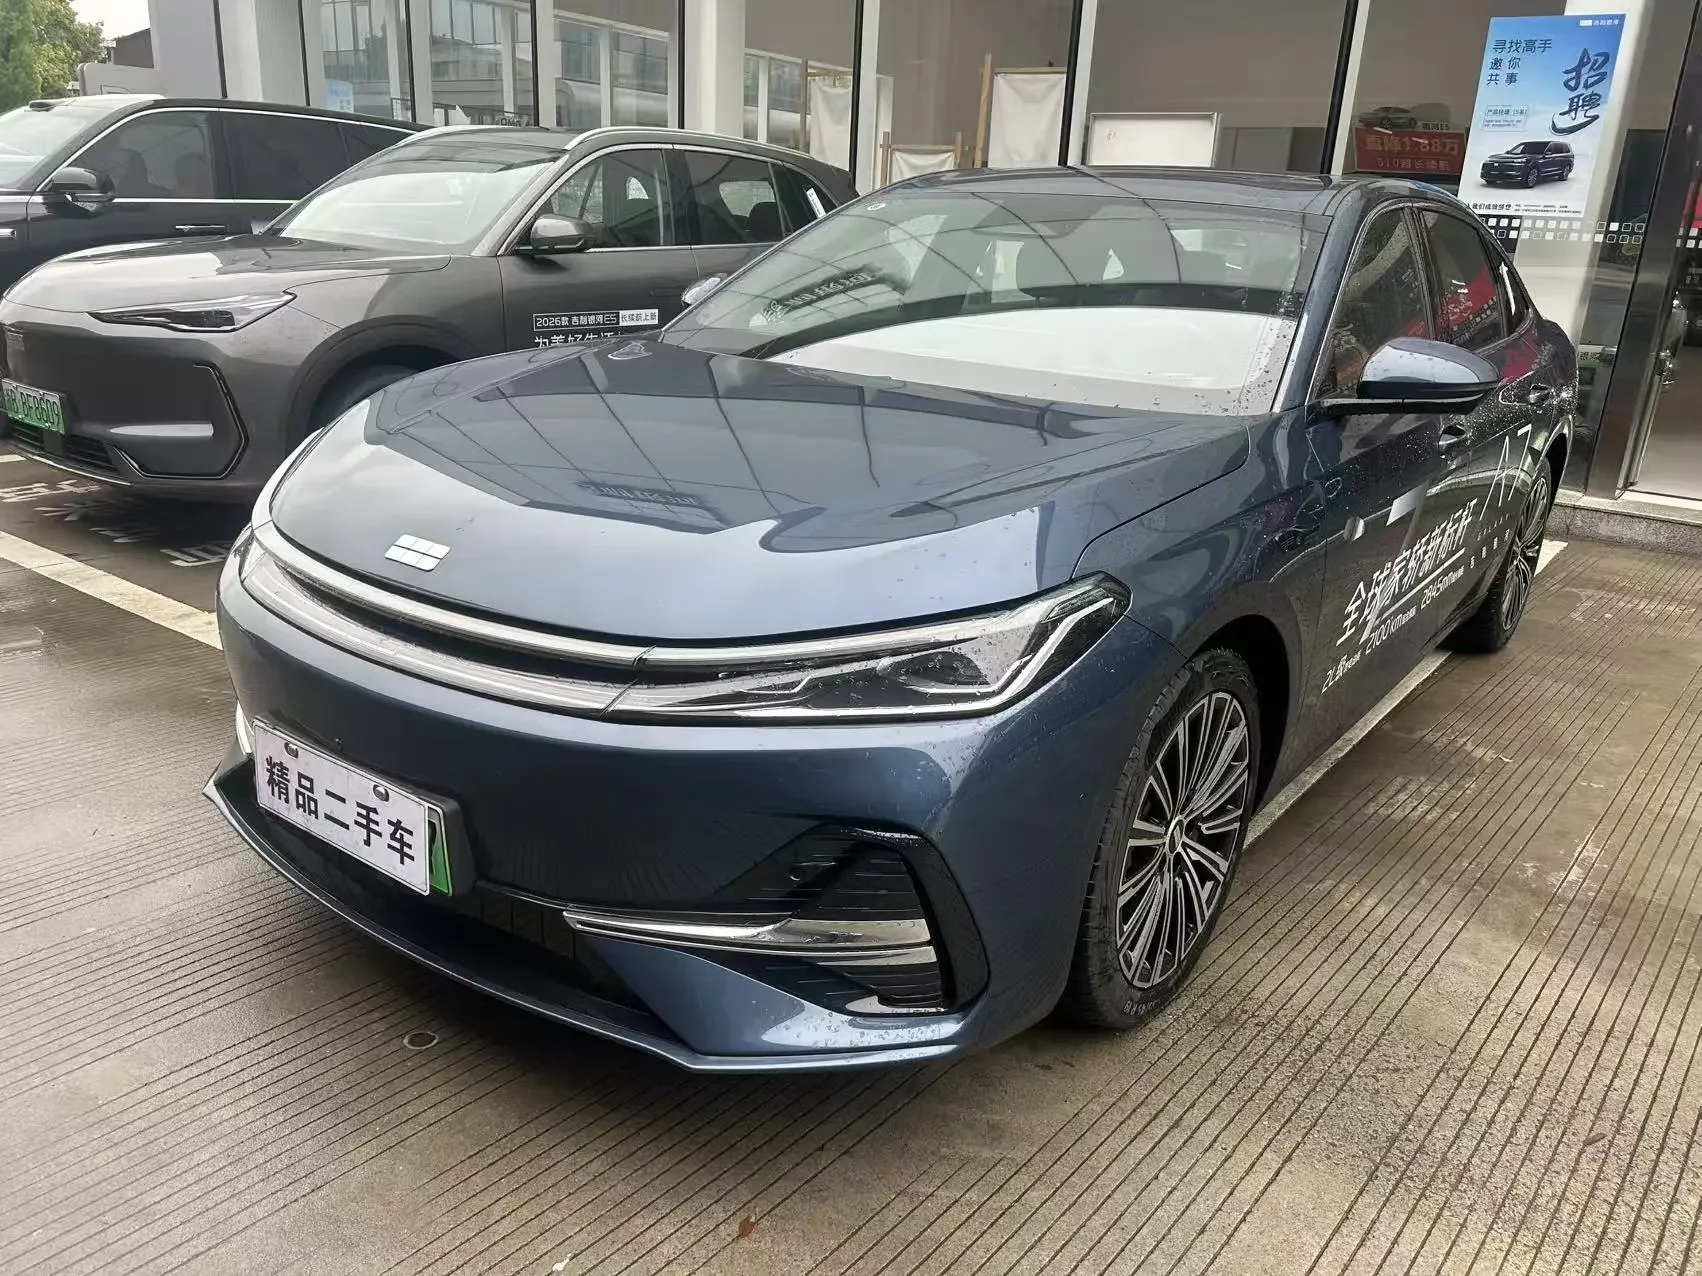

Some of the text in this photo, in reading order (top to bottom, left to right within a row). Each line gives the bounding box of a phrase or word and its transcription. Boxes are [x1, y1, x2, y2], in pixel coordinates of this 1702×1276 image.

[1492, 39, 1553, 54] 寻找高手
[1549, 48, 1610, 136] 招聘
[536, 316, 569, 327] 2026款
[1480, 424, 1532, 521] A7
[1336, 497, 1478, 647] 全球家轿新标杆
[265, 755, 415, 866] 精品二手车
